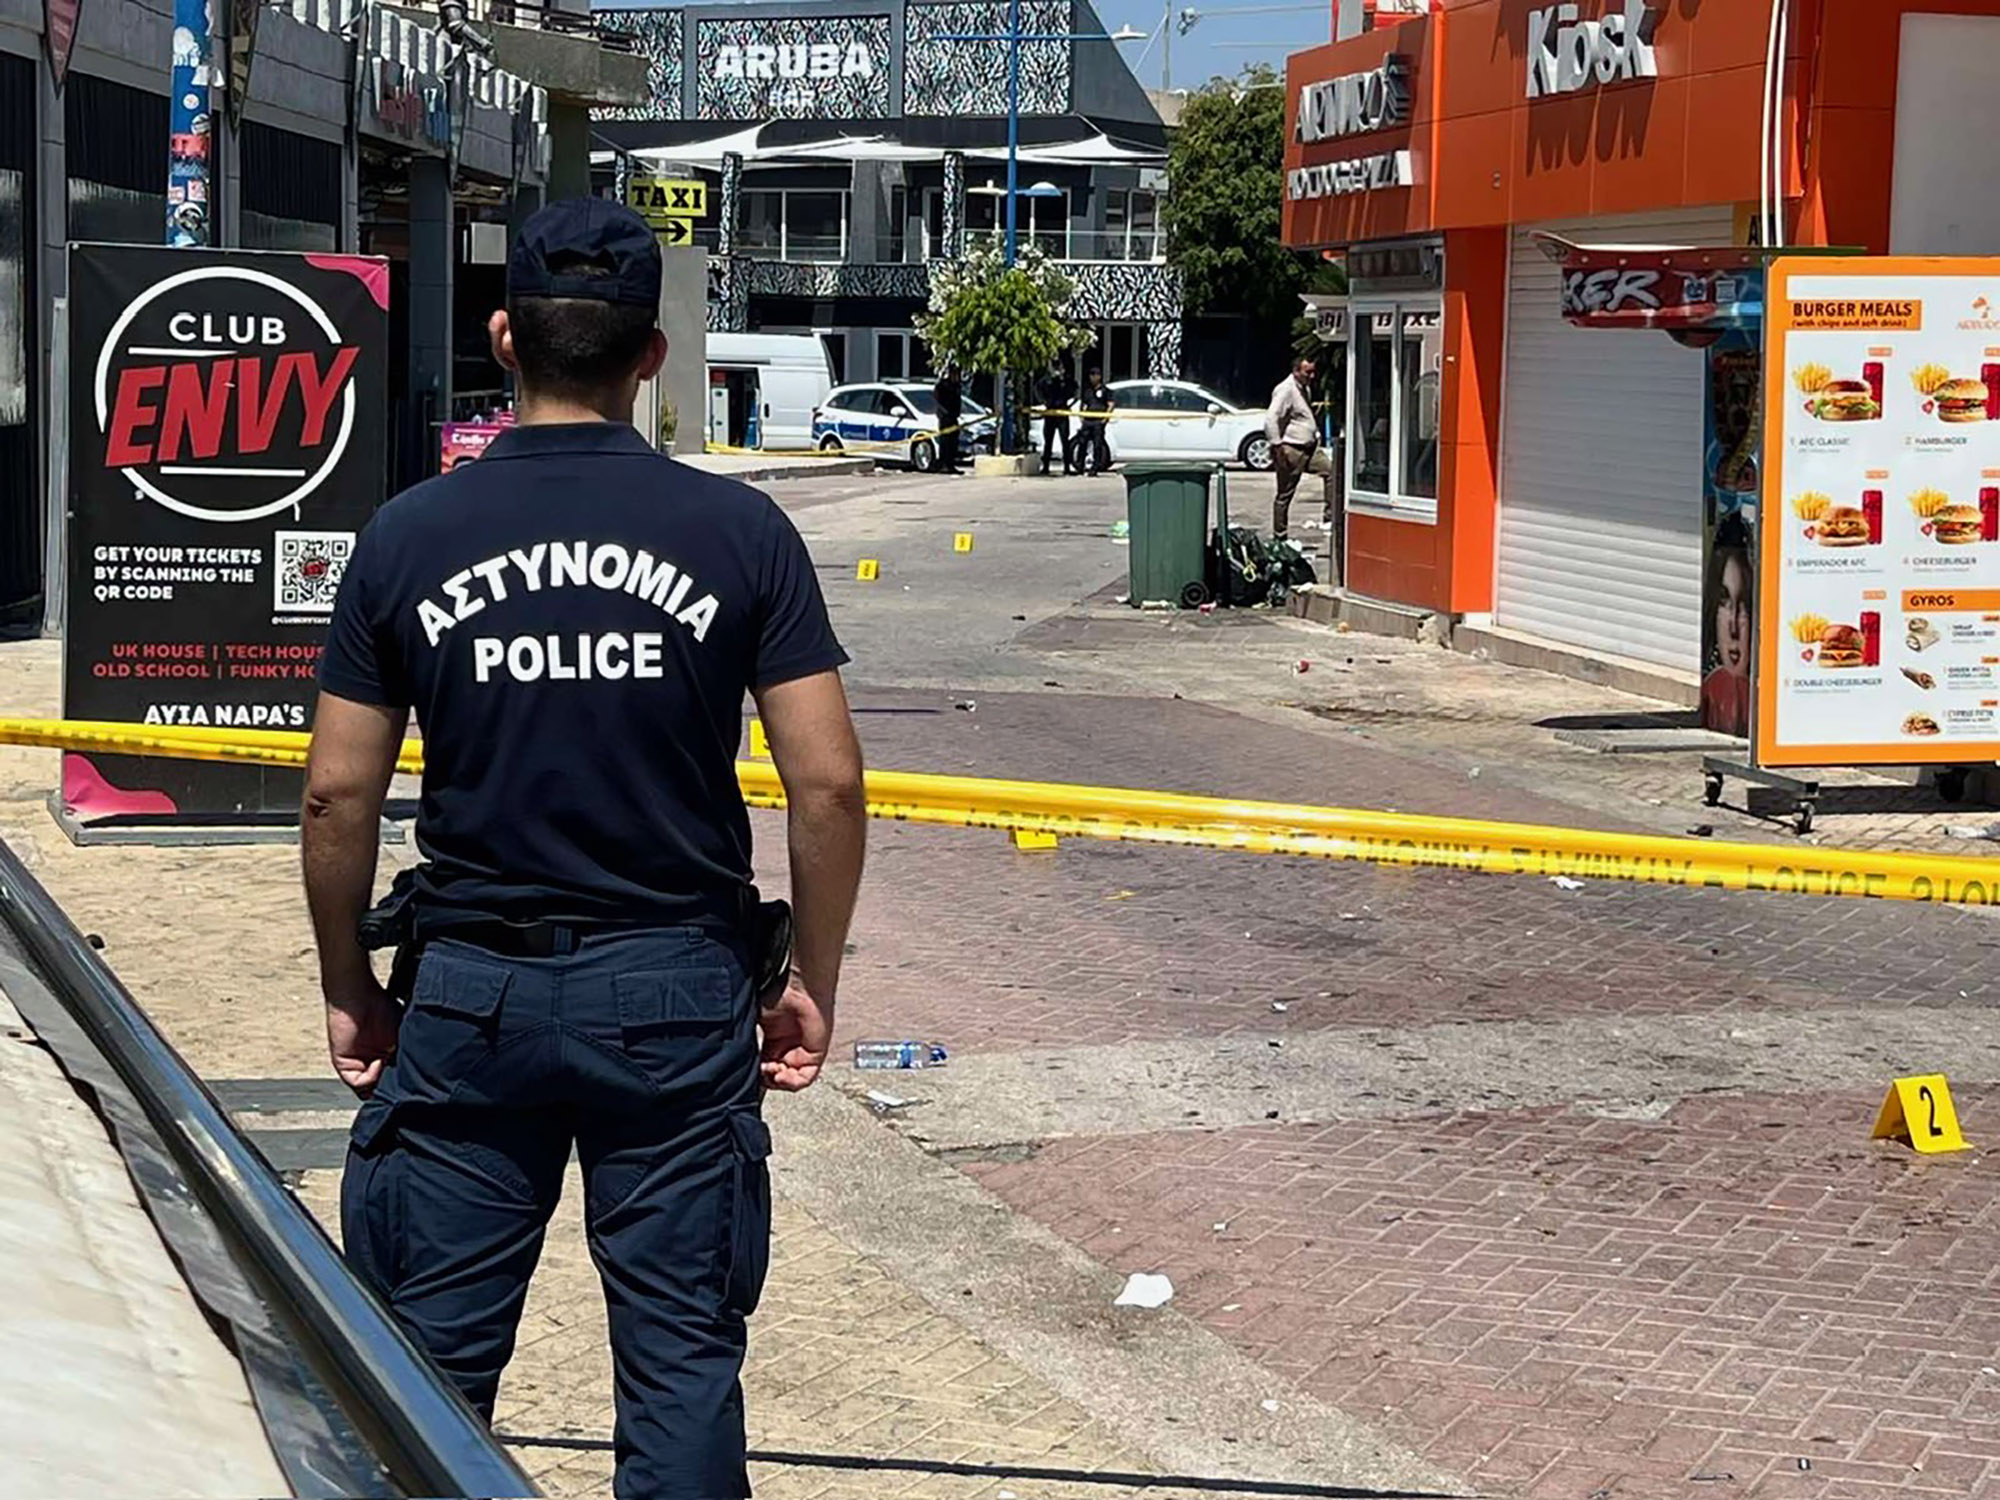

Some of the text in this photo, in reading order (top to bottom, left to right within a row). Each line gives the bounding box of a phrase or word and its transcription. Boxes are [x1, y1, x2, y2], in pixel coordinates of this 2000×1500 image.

[1525, 0, 1657, 98] Kiosk
[713, 43, 873, 79] ARUBA
[631, 186, 702, 209] TAXI
[1794, 303, 1912, 317] BURGER MEALS
[169, 313, 287, 344] CLUB
[105, 347, 360, 467] ENVY
[94, 547, 262, 564] GET YOUR TICKETS
[94, 567, 254, 583] BY SCANNING THE
[94, 586, 173, 602] QR CODE
[416, 541, 719, 647] ΑΣΤΥΝΟΜΙΑ
[1910, 595, 1954, 606] GYROS
[112, 644, 138, 657] UK
[143, 644, 205, 658] HOUSE
[226, 646, 271, 659] TECH
[276, 647, 325, 661] HOUS
[474, 632, 663, 682] POLICE
[93, 664, 130, 677] OLD
[135, 665, 210, 677] SCHOOL
[230, 665, 290, 677] FUNKY
[144, 705, 304, 725] AYIA NAPA'S
[1919, 1085, 1943, 1137] 2
